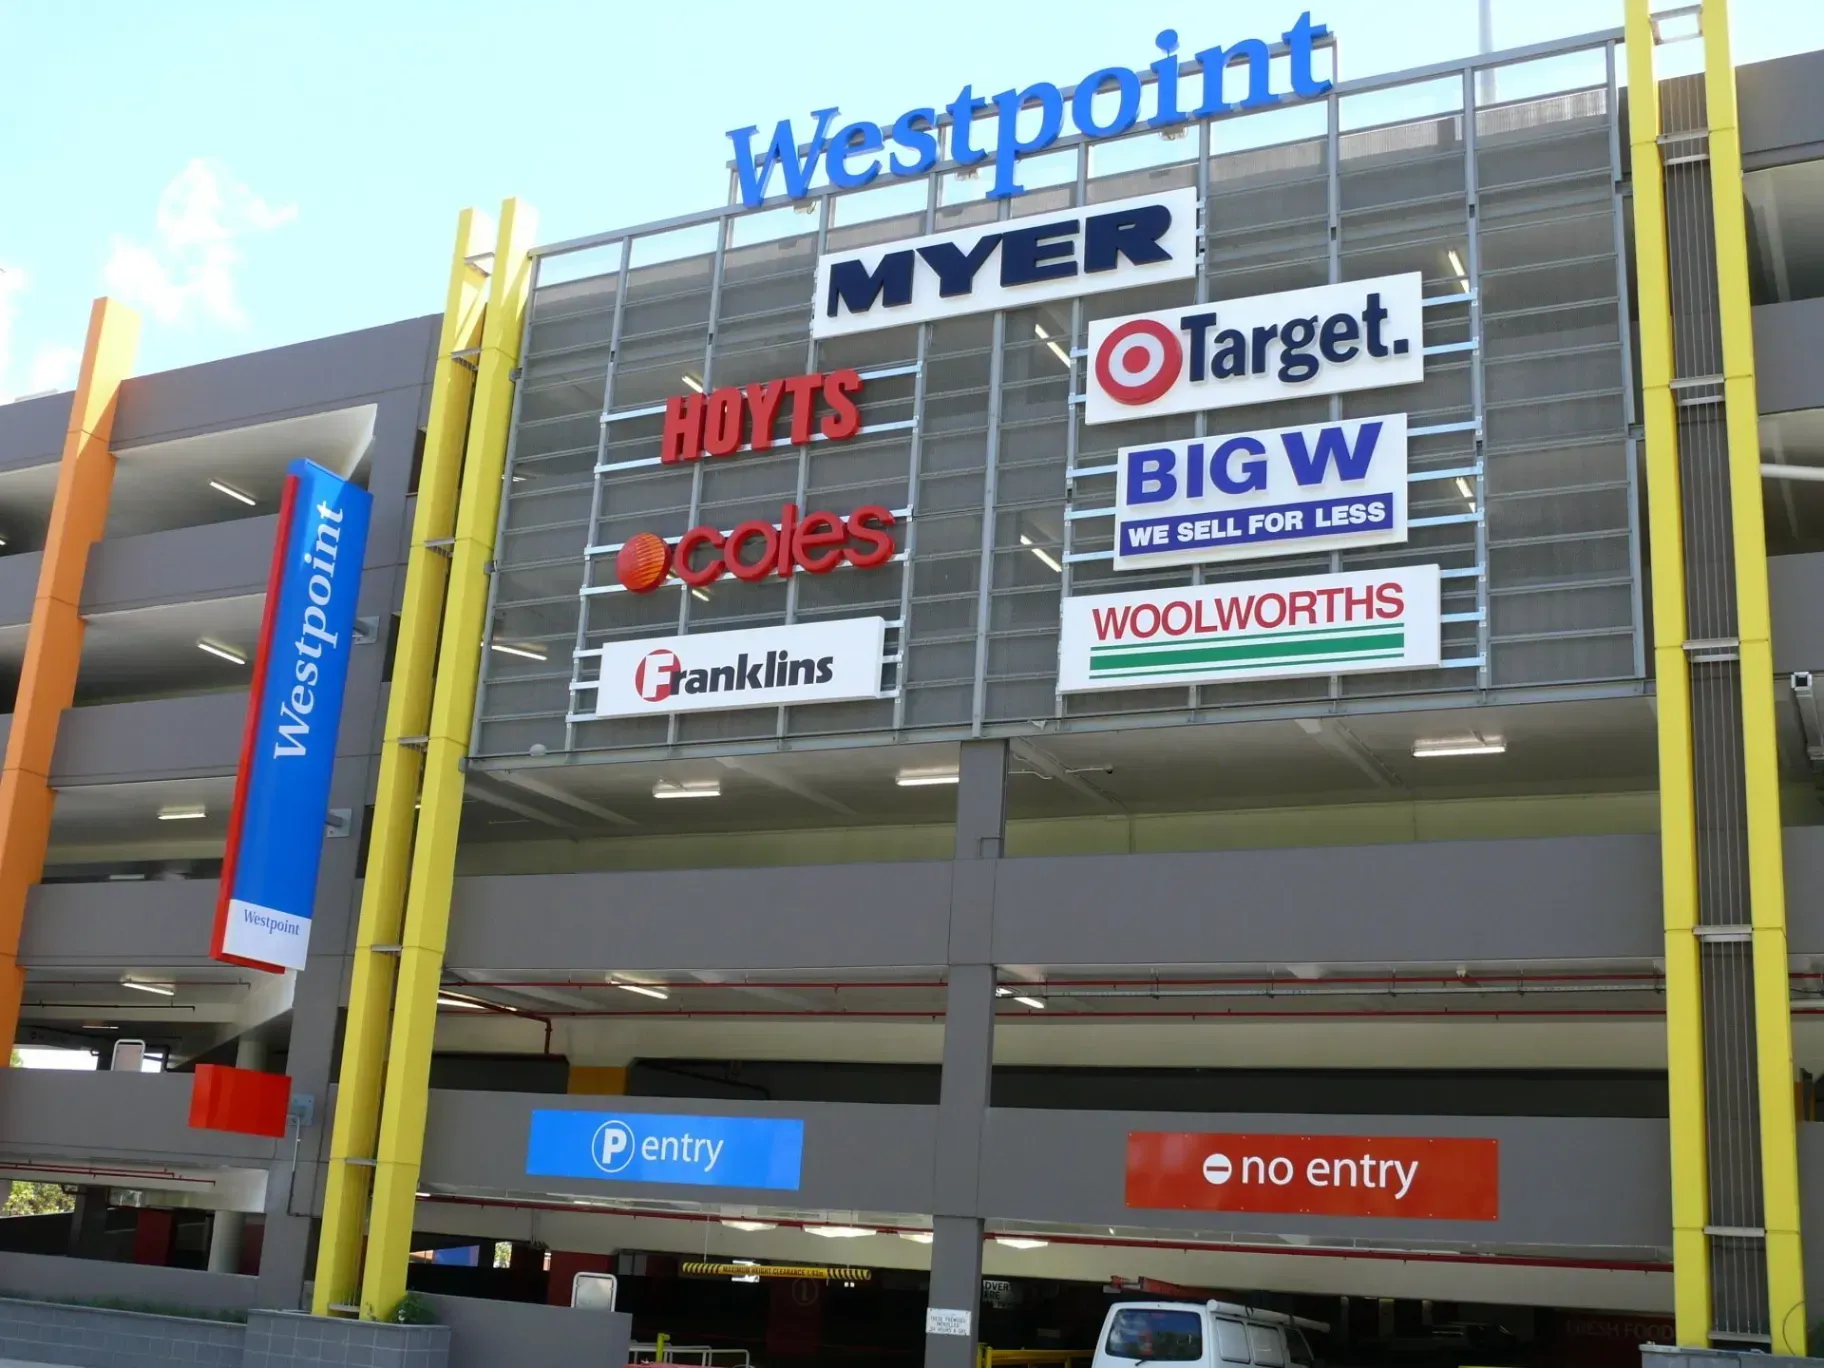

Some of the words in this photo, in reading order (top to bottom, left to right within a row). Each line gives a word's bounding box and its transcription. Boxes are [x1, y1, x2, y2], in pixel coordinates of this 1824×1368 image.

[726, 10, 1333, 207] Westpoint
[827, 204, 1173, 317] MYER
[661, 369, 863, 464] HOYTS
[1126, 436, 1267, 506] BIG
[1280, 421, 1383, 487] W
[673, 502, 896, 587] coles
[1128, 524, 1169, 547] WE
[1176, 517, 1242, 541] SELL
[1248, 511, 1303, 535] FOR
[1315, 502, 1386, 528] LESS
[272, 500, 343, 760] Westpoint
[1092, 582, 1404, 641] WOOLWORTHS
[640, 649, 834, 700] Franklins
[243, 908, 301, 936] Westpoint
[602, 1128, 627, 1165] P
[641, 1132, 724, 1172] entry
[1241, 1155, 1294, 1186] no
[1306, 1154, 1418, 1200] entry
[772, 1269, 805, 1277] CLEARANCE
[1624, 1322, 1674, 1341] FOOD
